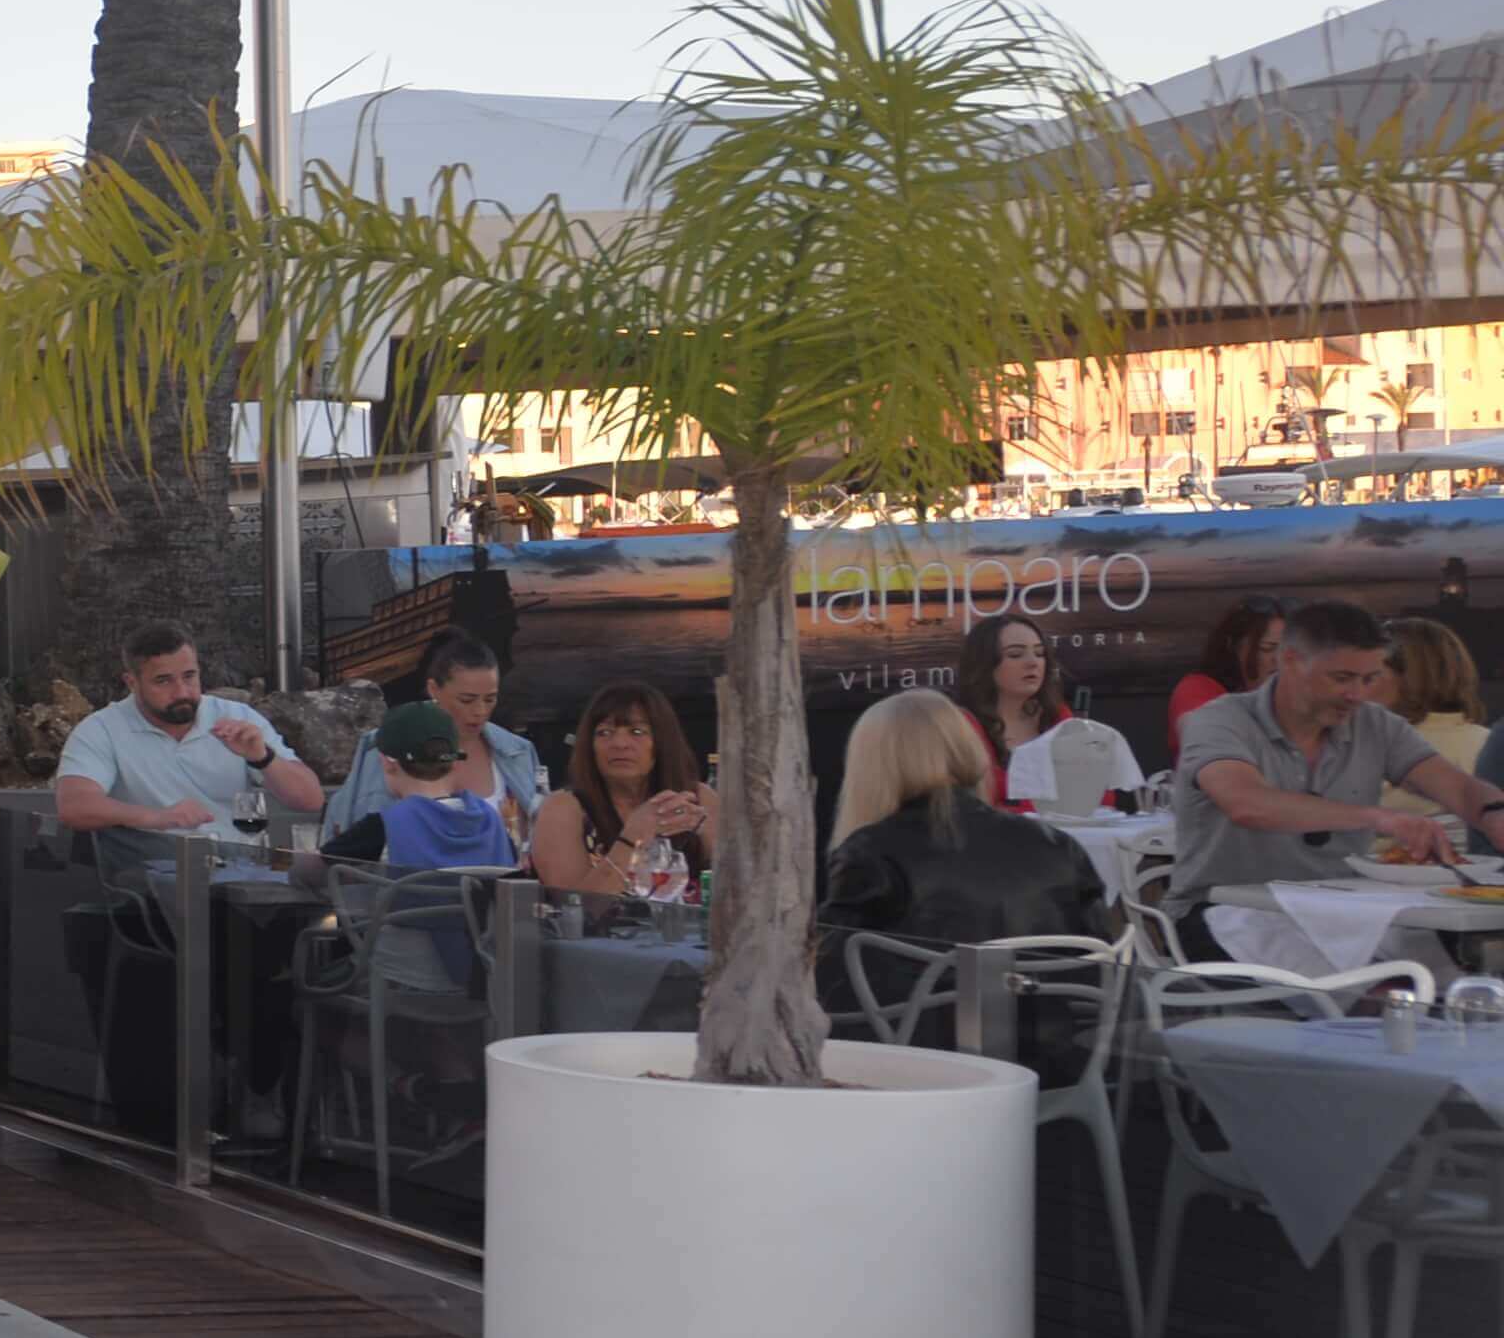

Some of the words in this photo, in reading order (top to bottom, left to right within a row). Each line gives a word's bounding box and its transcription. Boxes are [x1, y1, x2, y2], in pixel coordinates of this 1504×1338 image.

[810, 548, 1151, 635] lamparo
[1050, 631, 1146, 648] TORIA
[838, 664, 955, 692] vilam
